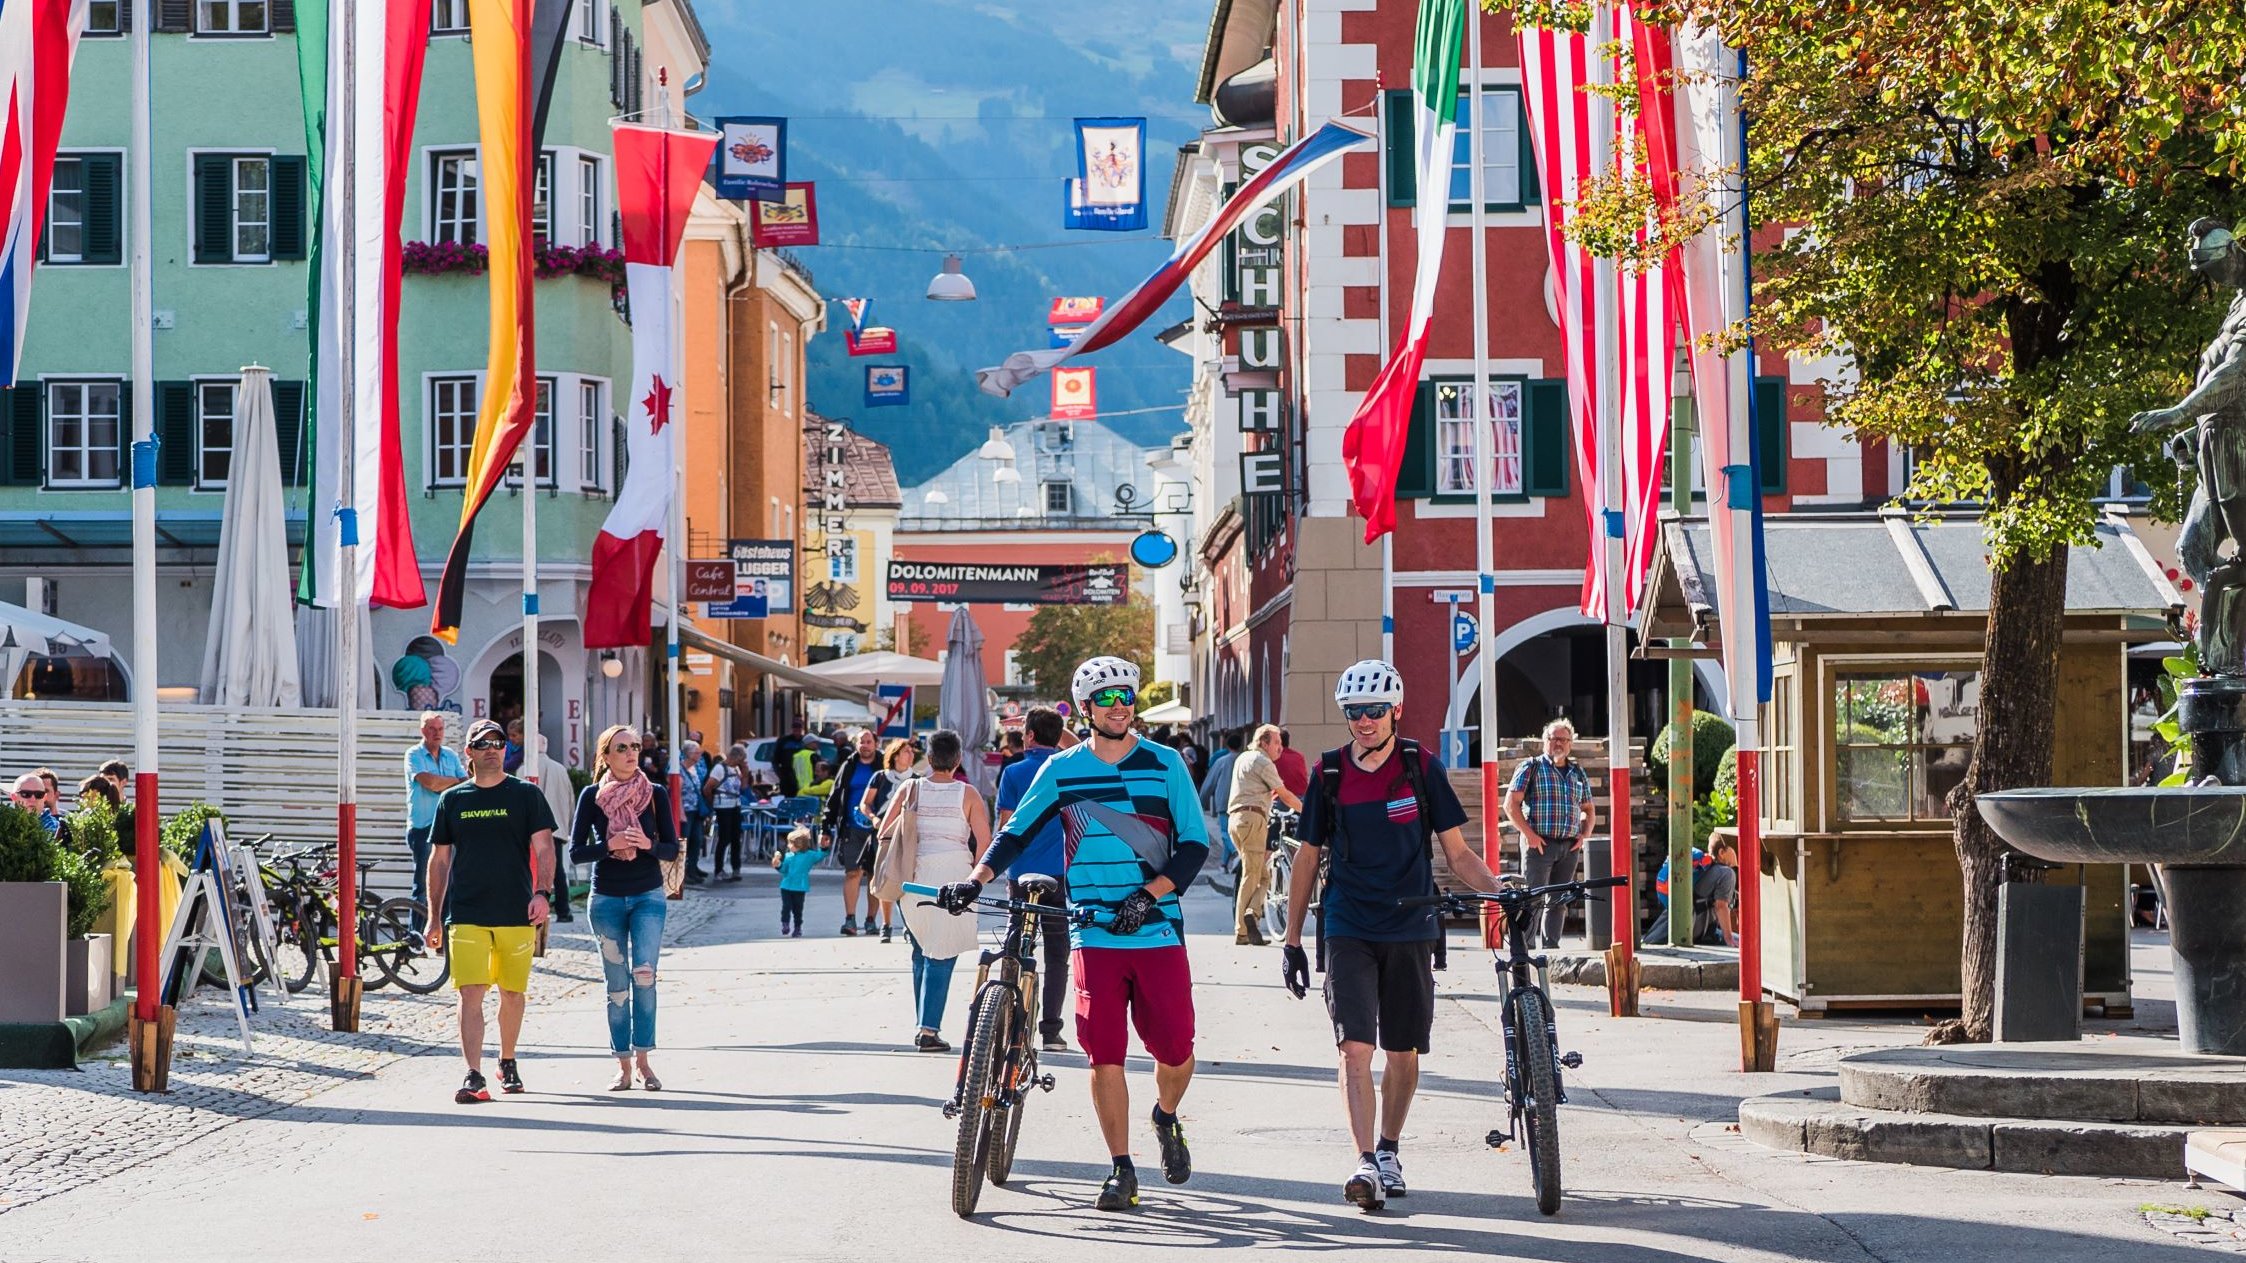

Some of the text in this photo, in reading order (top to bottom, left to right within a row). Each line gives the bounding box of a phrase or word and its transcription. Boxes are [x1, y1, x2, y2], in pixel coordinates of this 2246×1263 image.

[1241, 145, 1282, 492] SCHUHE
[826, 424, 844, 557] ZIMMER
[737, 562, 790, 575] LUGGER
[890, 565, 1039, 582] DOLOMITENMANN
[690, 583, 731, 596] Central
[889, 582, 959, 594] 09. 09. 2017
[1083, 588, 1121, 596] DOLOMITEN
[1456, 623, 1471, 640] P
[568, 699, 581, 768] EIS
[460, 808, 508, 819] SKYWALK
